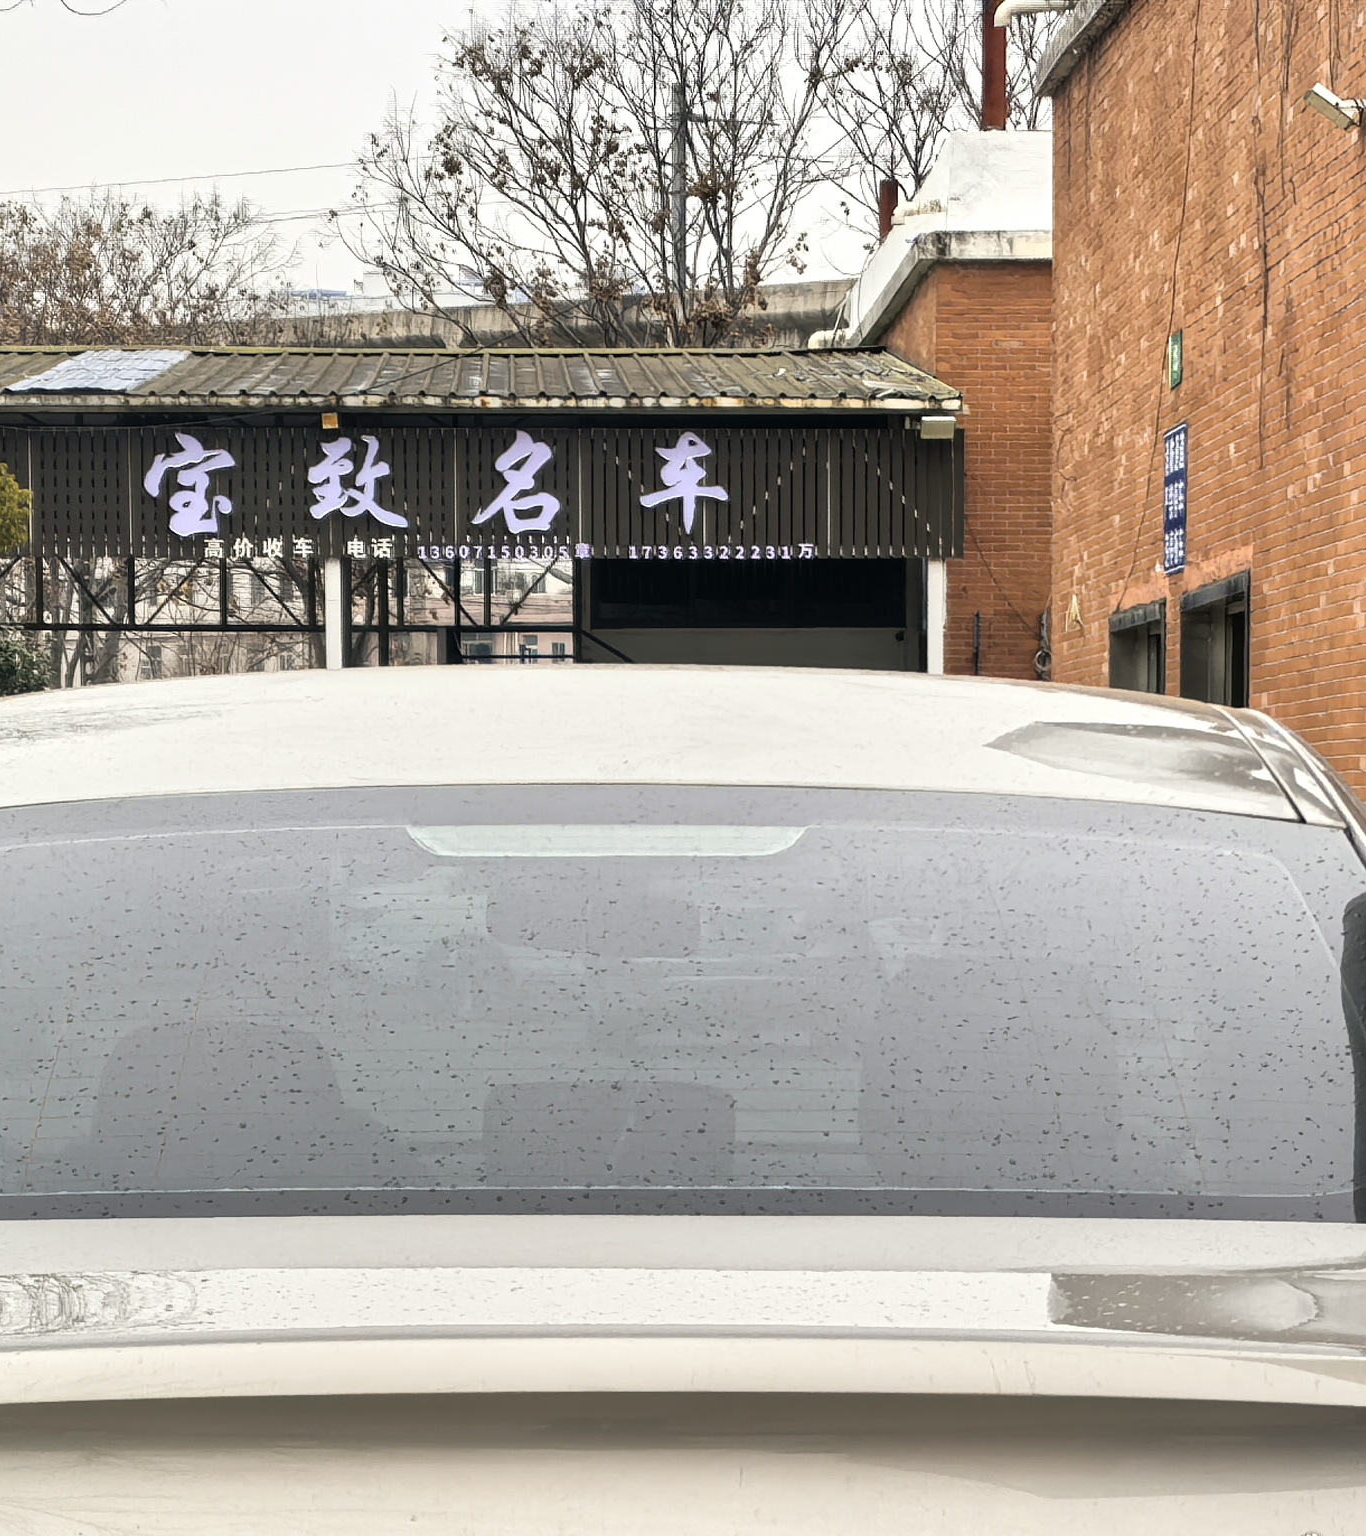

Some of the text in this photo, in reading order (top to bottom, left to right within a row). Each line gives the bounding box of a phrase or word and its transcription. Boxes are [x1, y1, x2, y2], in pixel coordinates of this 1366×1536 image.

[143, 431, 729, 537] 宝致名车
[203, 537, 315, 559] 高价收车
[346, 537, 393, 559] 电话
